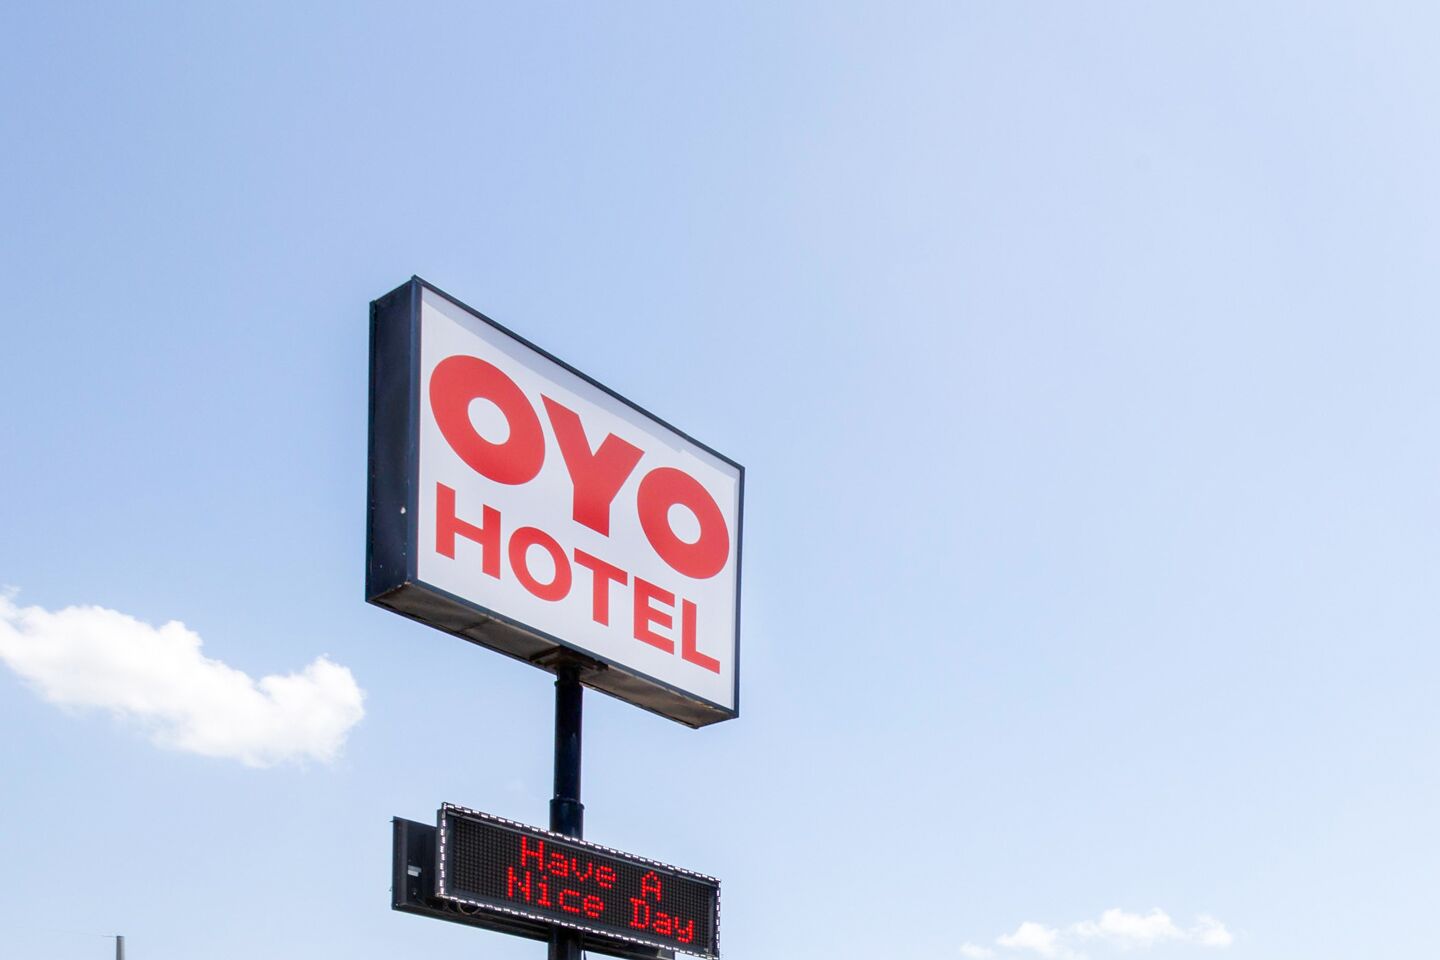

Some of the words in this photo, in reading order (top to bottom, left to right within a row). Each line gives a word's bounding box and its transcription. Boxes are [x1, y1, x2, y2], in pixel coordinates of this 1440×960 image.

[430, 355, 730, 580] OYO
[436, 482, 721, 674] HOTEL
[507, 866, 605, 919] Nice
[629, 896, 694, 944] Day
[520, 835, 617, 890] Have
[641, 870, 662, 902] A
